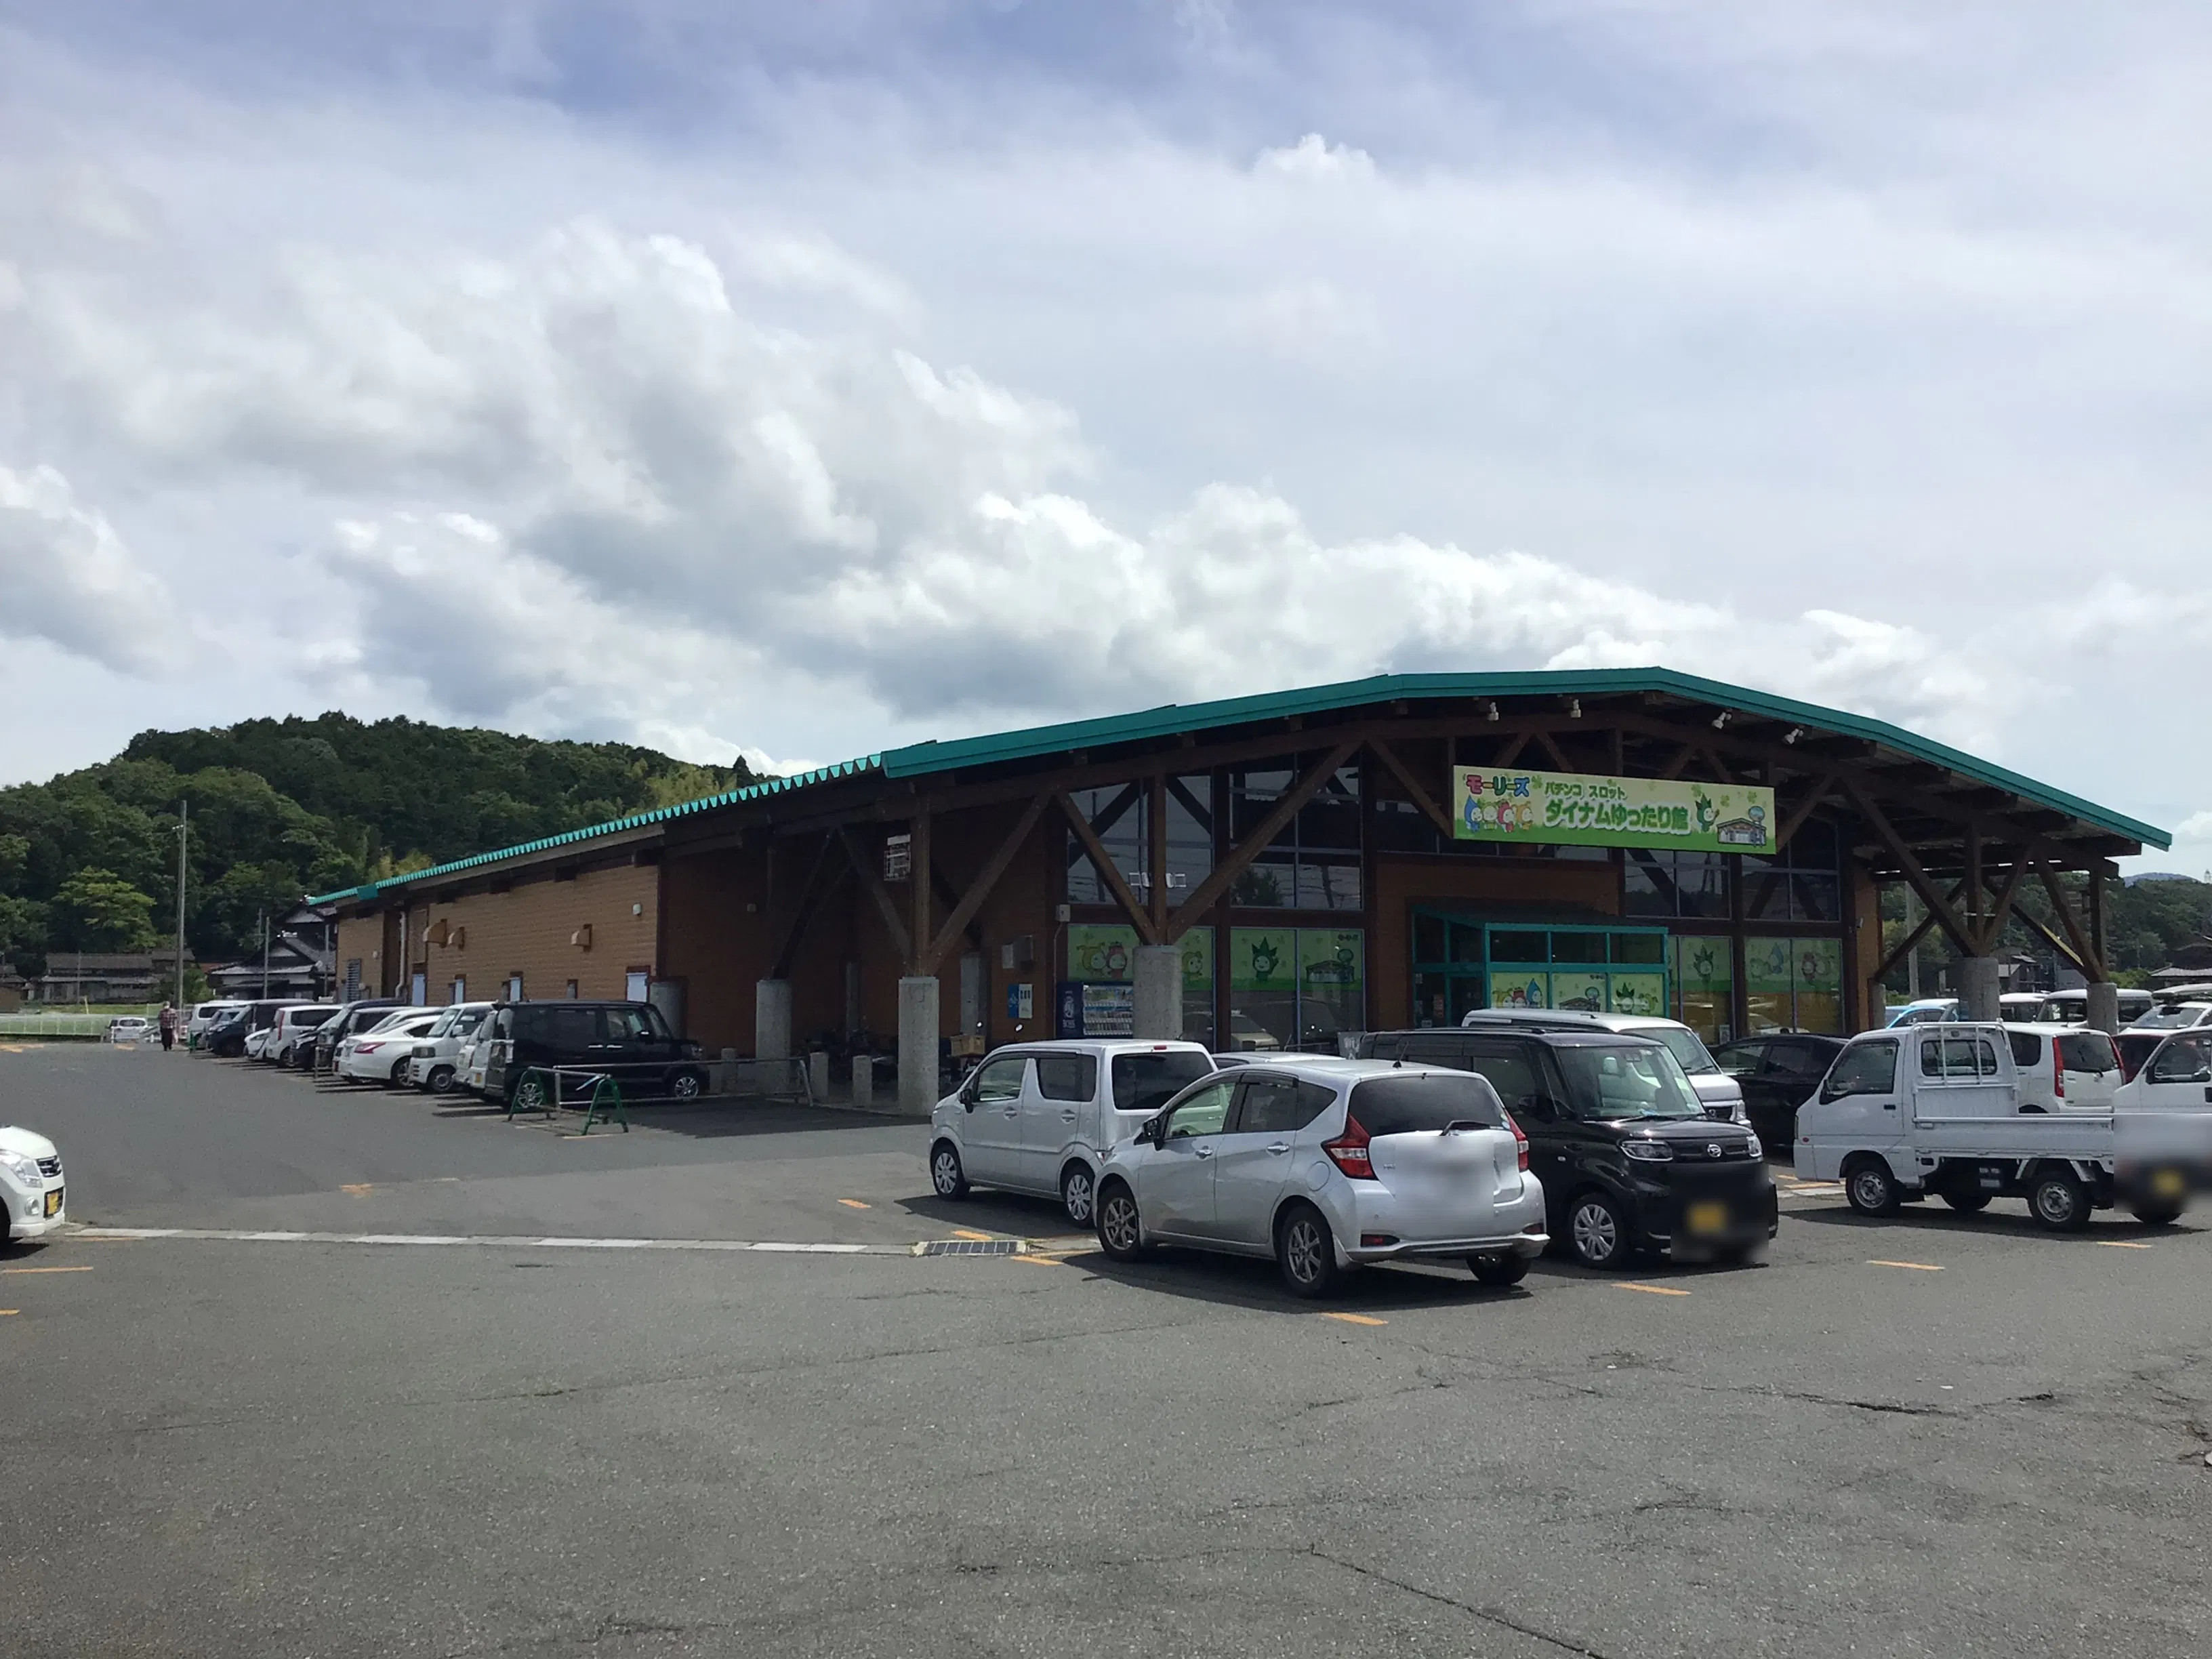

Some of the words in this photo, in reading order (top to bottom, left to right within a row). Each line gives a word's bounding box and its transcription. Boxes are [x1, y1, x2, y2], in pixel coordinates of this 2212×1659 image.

[1466, 774, 1530, 798] モーリーズ
[1544, 781, 1582, 797] パチンコ
[1588, 784, 1627, 800] スロット
